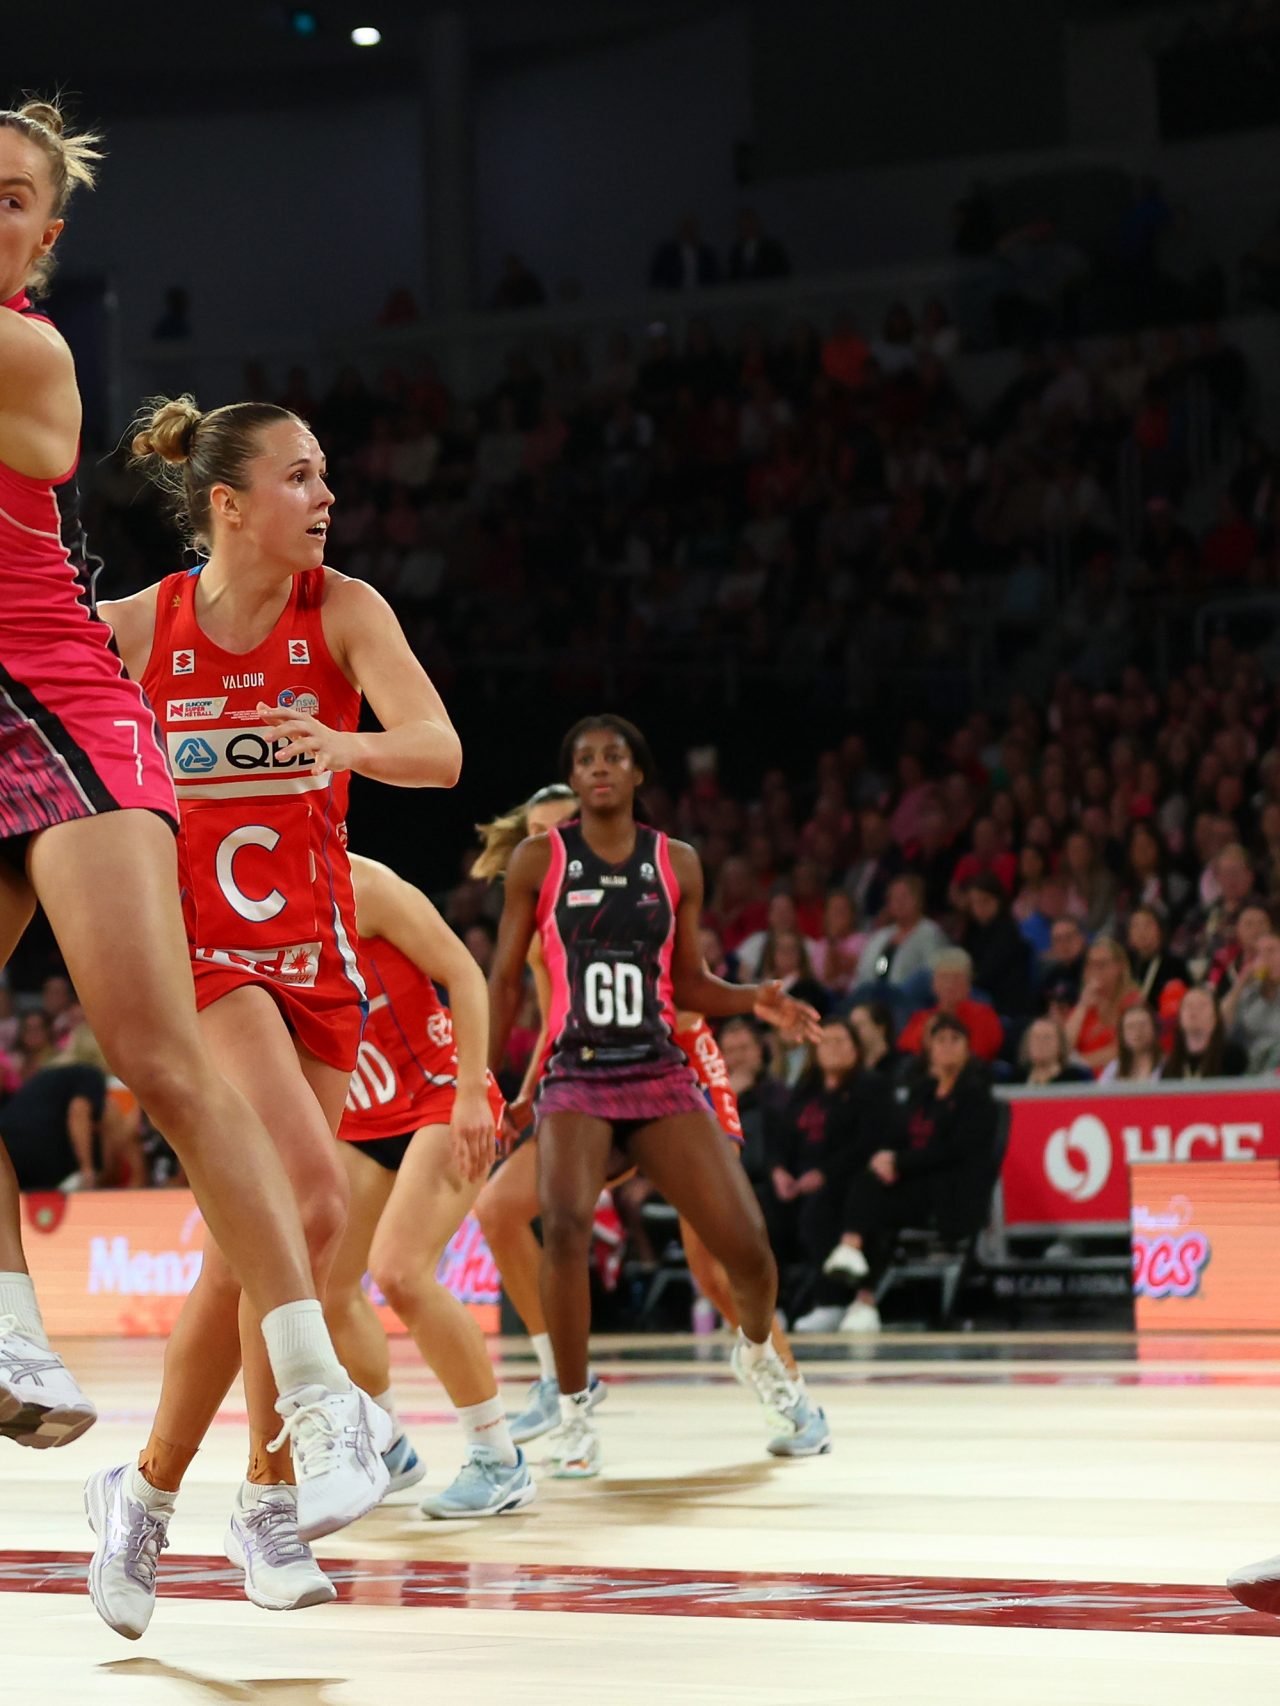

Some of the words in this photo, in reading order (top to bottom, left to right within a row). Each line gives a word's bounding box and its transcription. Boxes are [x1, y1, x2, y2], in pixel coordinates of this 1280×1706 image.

[222, 672, 265, 690] VALOUR
[113, 720, 144, 787] 7
[215, 823, 288, 923] C
[584, 961, 645, 1029] GD
